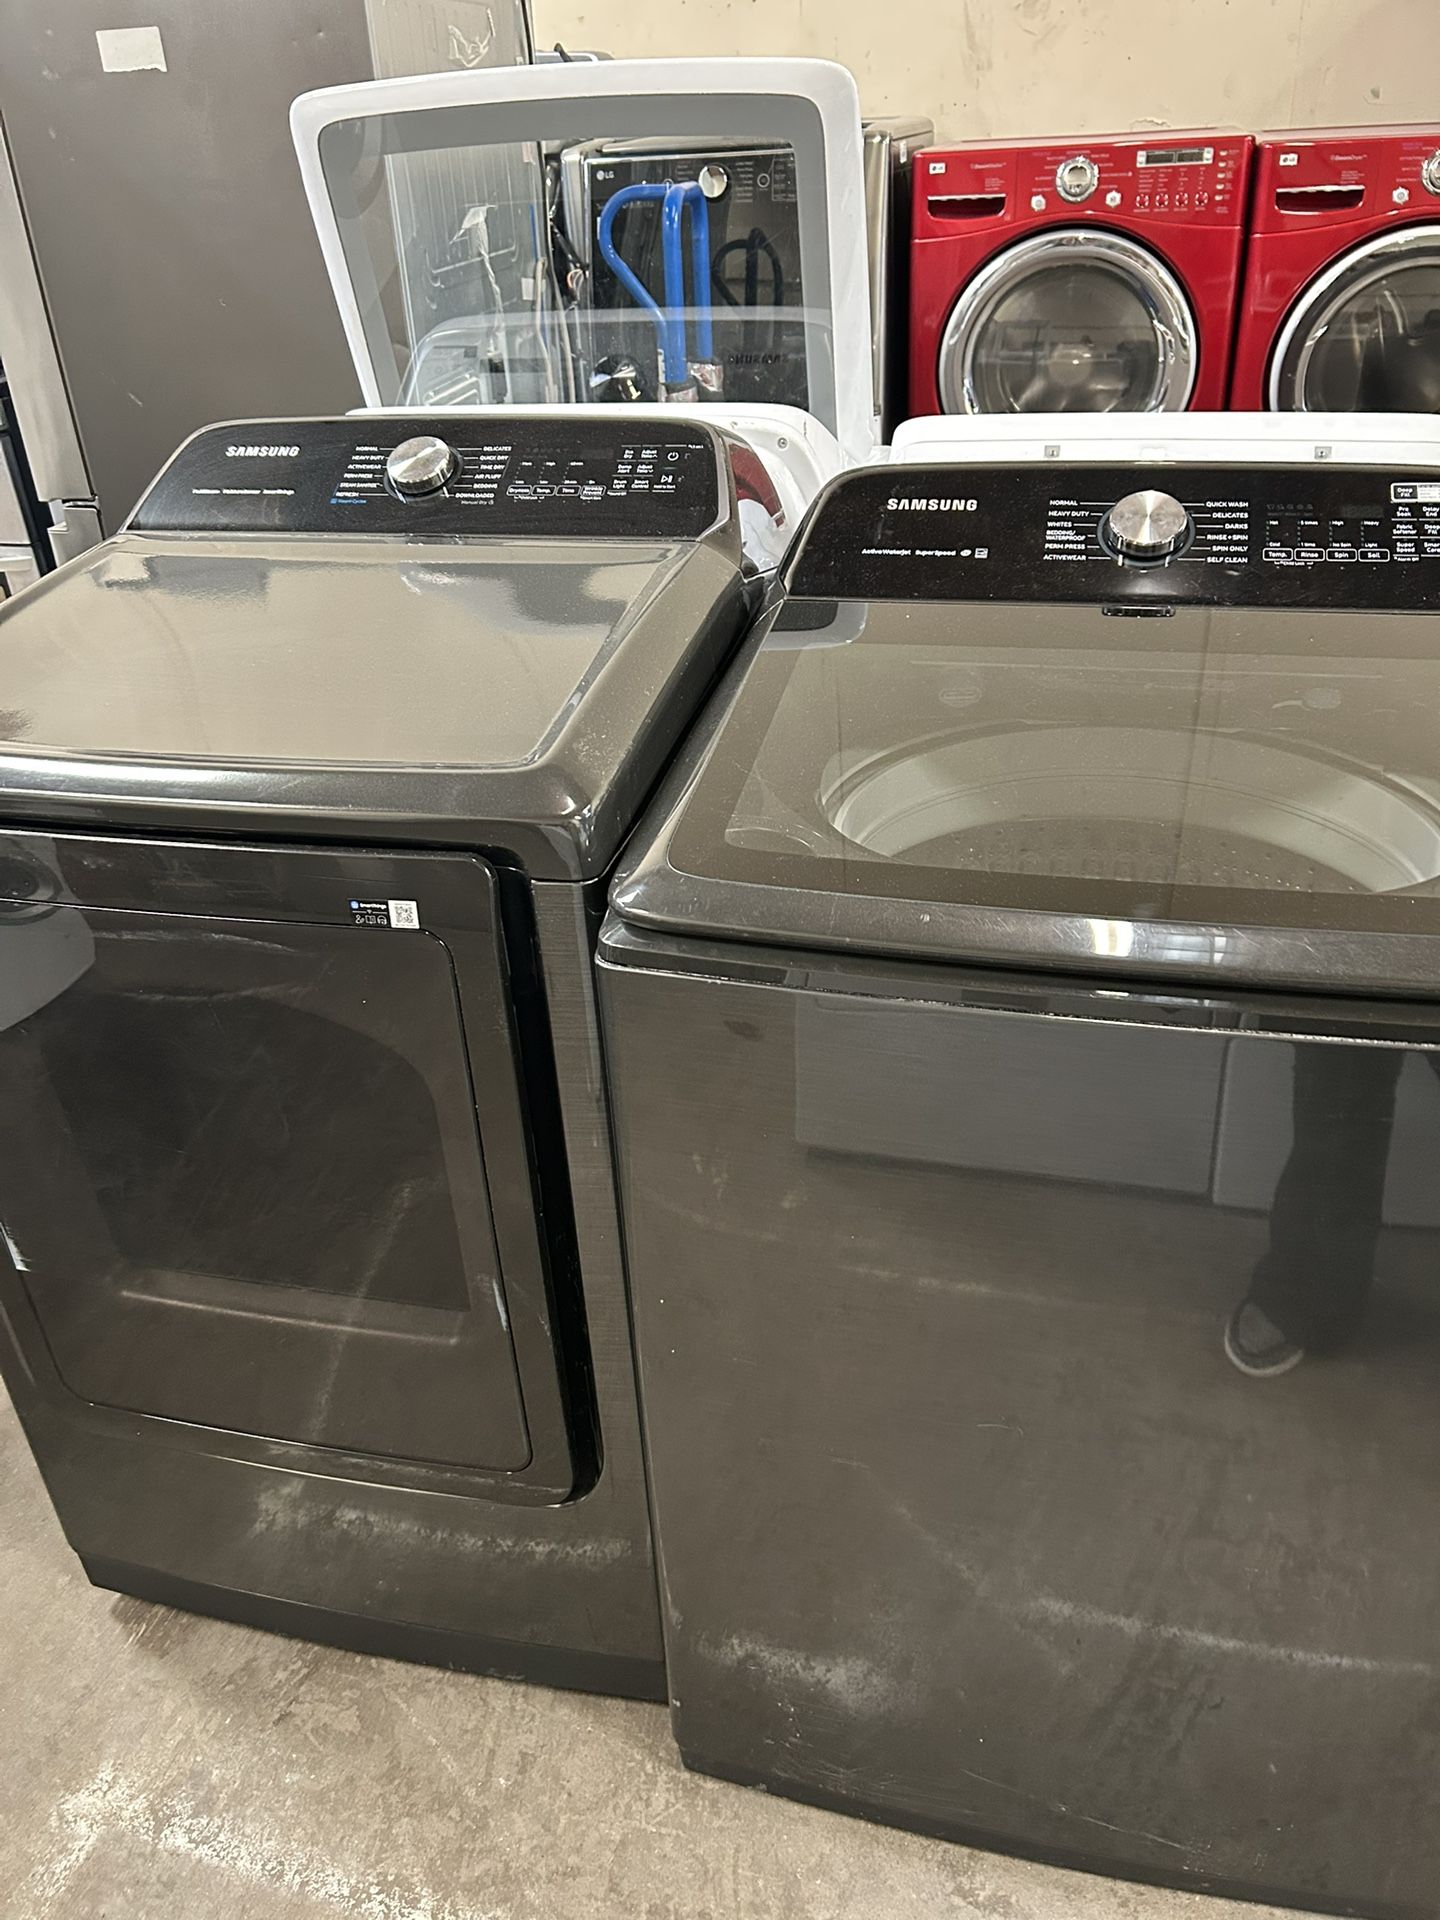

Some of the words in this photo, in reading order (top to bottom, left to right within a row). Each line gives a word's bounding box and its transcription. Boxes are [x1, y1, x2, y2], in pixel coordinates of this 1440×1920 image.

[225, 446, 301, 457] SAMSUNG
[886, 498, 978, 511] SAMSUNG
[1268, 551, 1288, 559] Temp.
